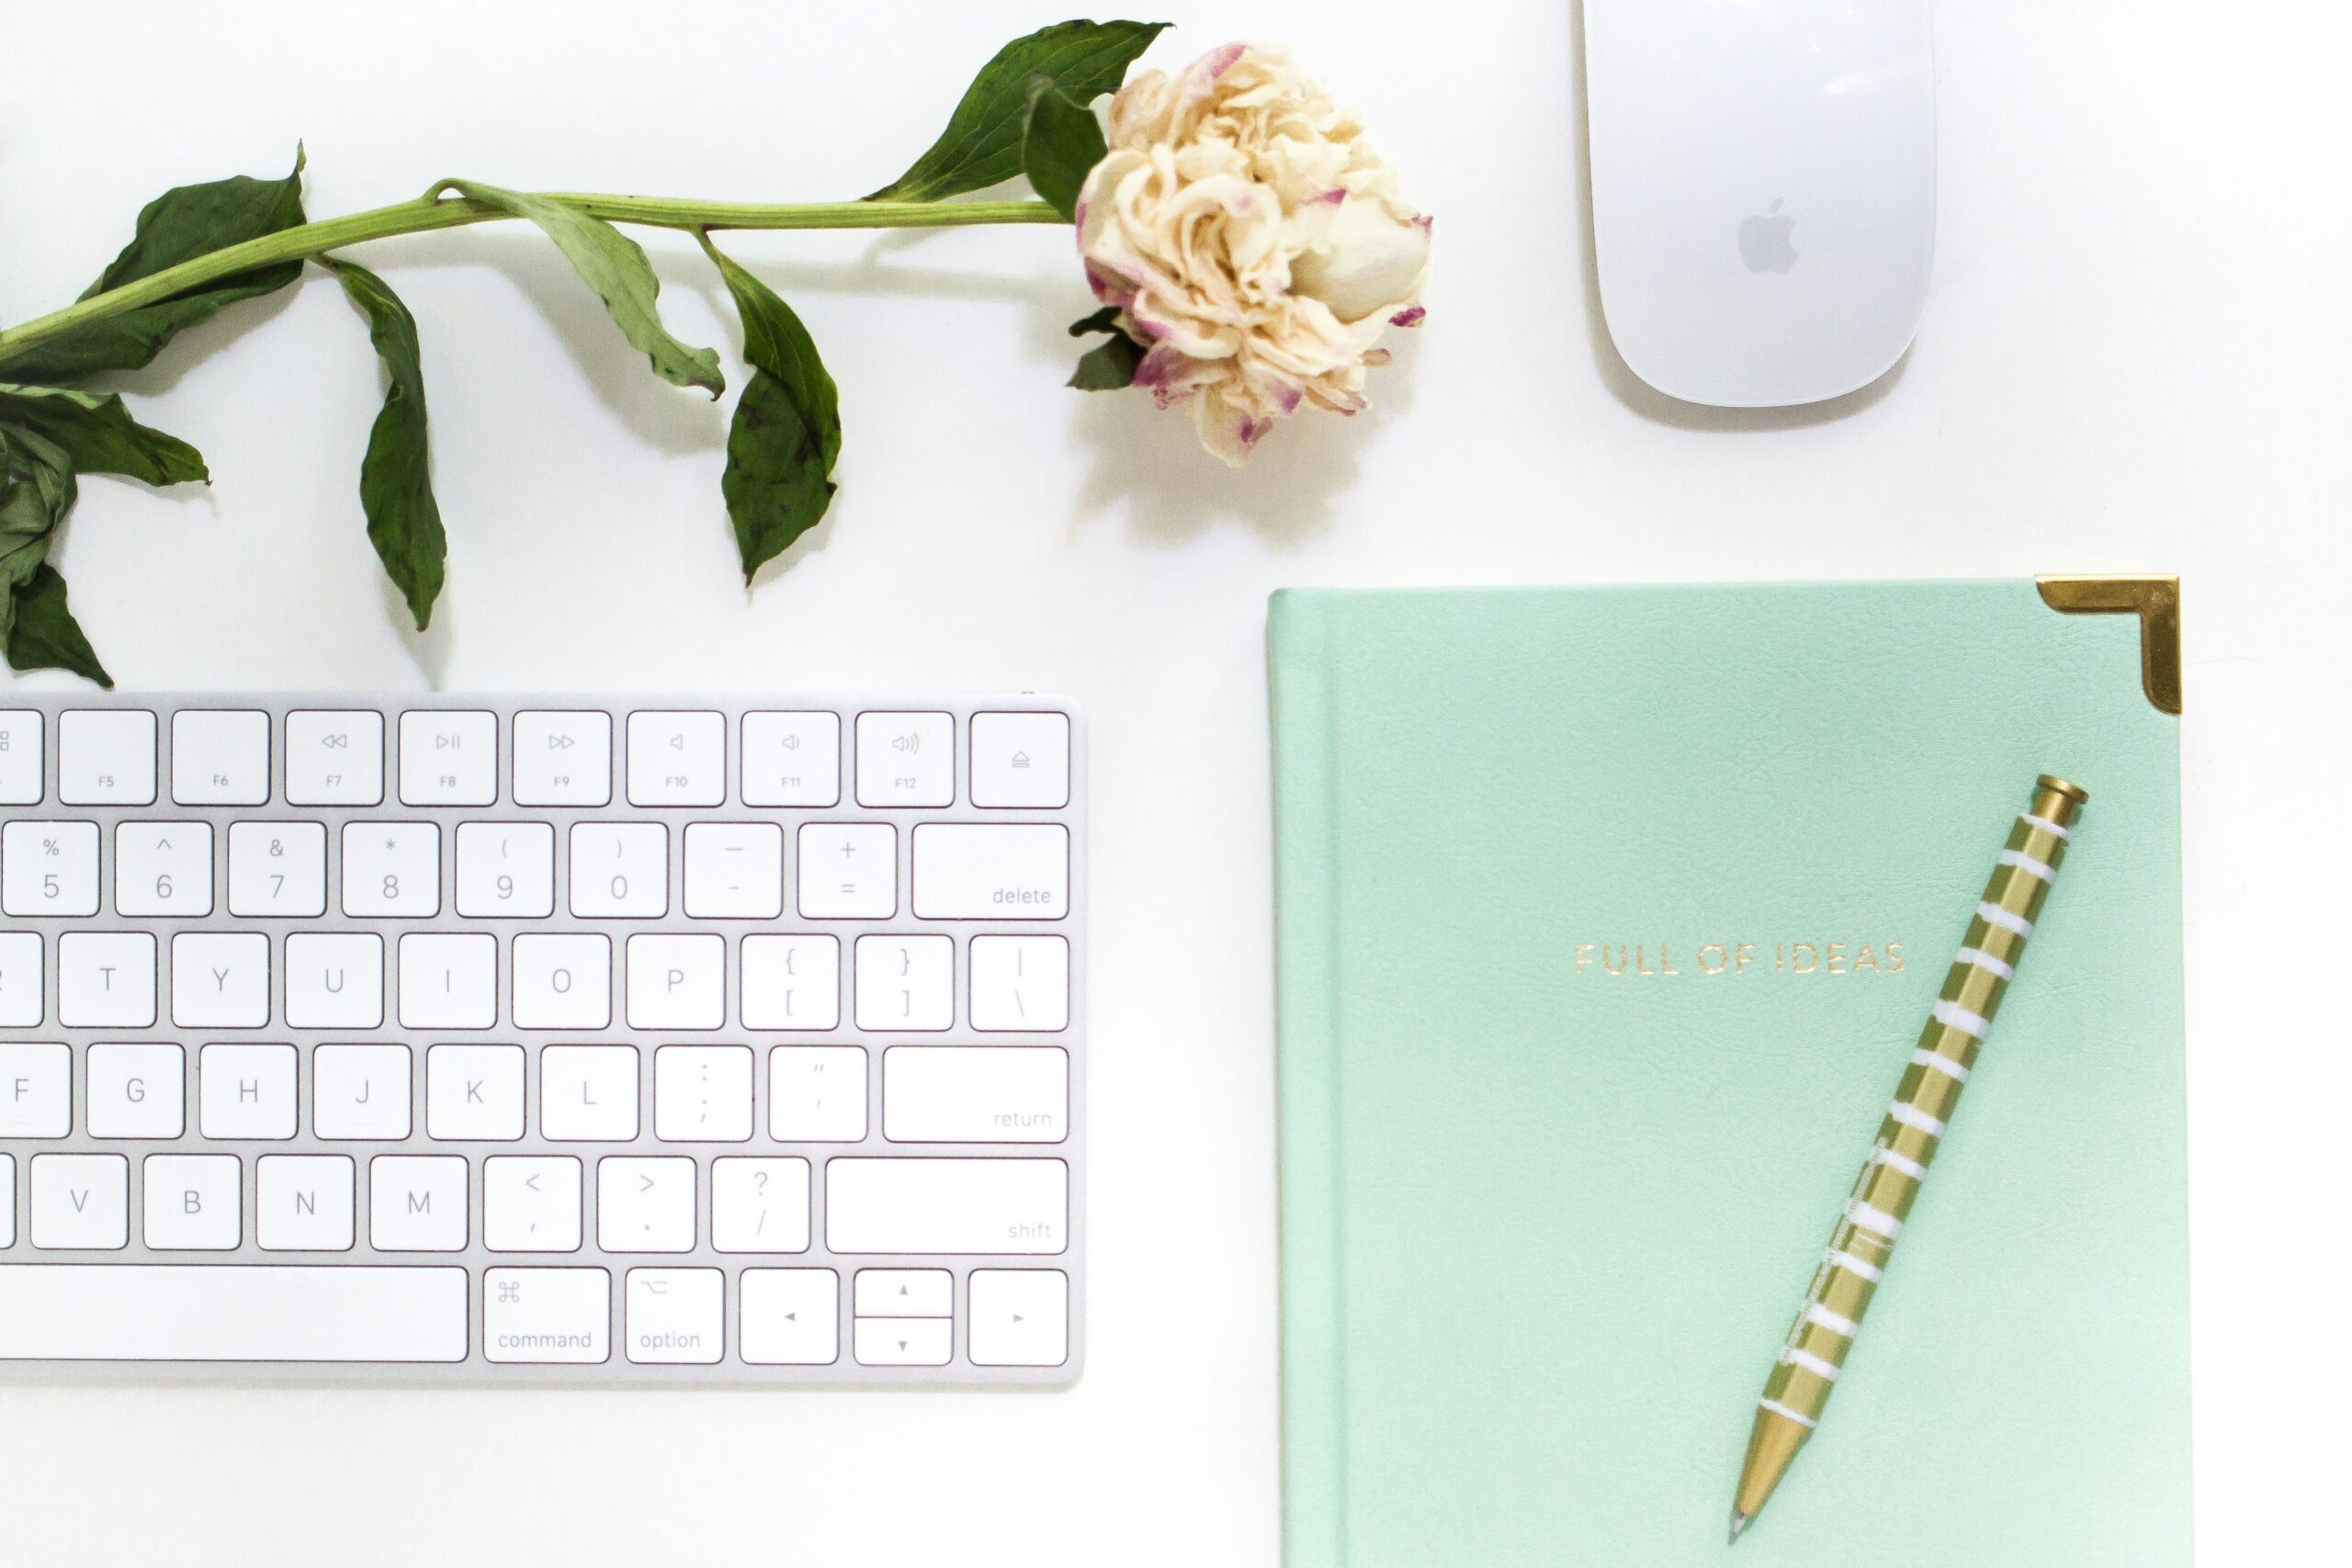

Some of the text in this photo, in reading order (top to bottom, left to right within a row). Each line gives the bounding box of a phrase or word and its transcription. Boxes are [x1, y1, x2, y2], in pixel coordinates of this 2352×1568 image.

[98, 776, 114, 787] F5
[213, 775, 228, 785] F6
[326, 775, 342, 785] F7
[441, 776, 456, 786] F8
[554, 776, 570, 786] F9
[666, 776, 687, 787] F10
[782, 776, 800, 786] F11
[895, 778, 916, 789] F12
[43, 840, 59, 855] %
[157, 839, 171, 849] ^
[270, 840, 283, 856] &
[501, 840, 508, 858] (
[841, 842, 856, 858] +
[44, 874, 59, 898] 5
[156, 874, 172, 898] 6
[270, 874, 284, 898] 7
[383, 874, 399, 898] 8
[497, 875, 513, 899] 9
[611, 875, 628, 899] 0
[842, 884, 855, 893] =
[993, 888, 1051, 903] delete
[786, 948, 795, 976] {
[900, 949, 910, 976] }
[1575, 942, 1905, 976] FULL OF IDEAS
[99, 968, 116, 991] T
[213, 969, 229, 992] Y
[326, 969, 343, 993] U
[552, 969, 571, 993] O
[668, 969, 684, 992] P
[786, 990, 794, 1016] [
[902, 990, 910, 1017] ]
[1014, 990, 1024, 1017] \
[16, 1078, 28, 1101] F
[127, 1078, 144, 1102] G
[241, 1080, 257, 1102] H
[356, 1080, 368, 1103] J
[468, 1080, 482, 1103] K
[583, 1081, 596, 1104] L
[700, 1100, 708, 1123] ;
[995, 1112, 1051, 1126] return
[526, 1174, 539, 1191] <
[640, 1175, 654, 1192] >
[754, 1171, 768, 1196] ?
[71, 1190, 88, 1213] V
[185, 1190, 200, 1213] B
[297, 1191, 314, 1214] N
[409, 1191, 429, 1213] M
[757, 1209, 766, 1235] /
[1009, 1223, 1050, 1238] shift
[499, 1332, 591, 1348] command
[640, 1334, 699, 1350] option
